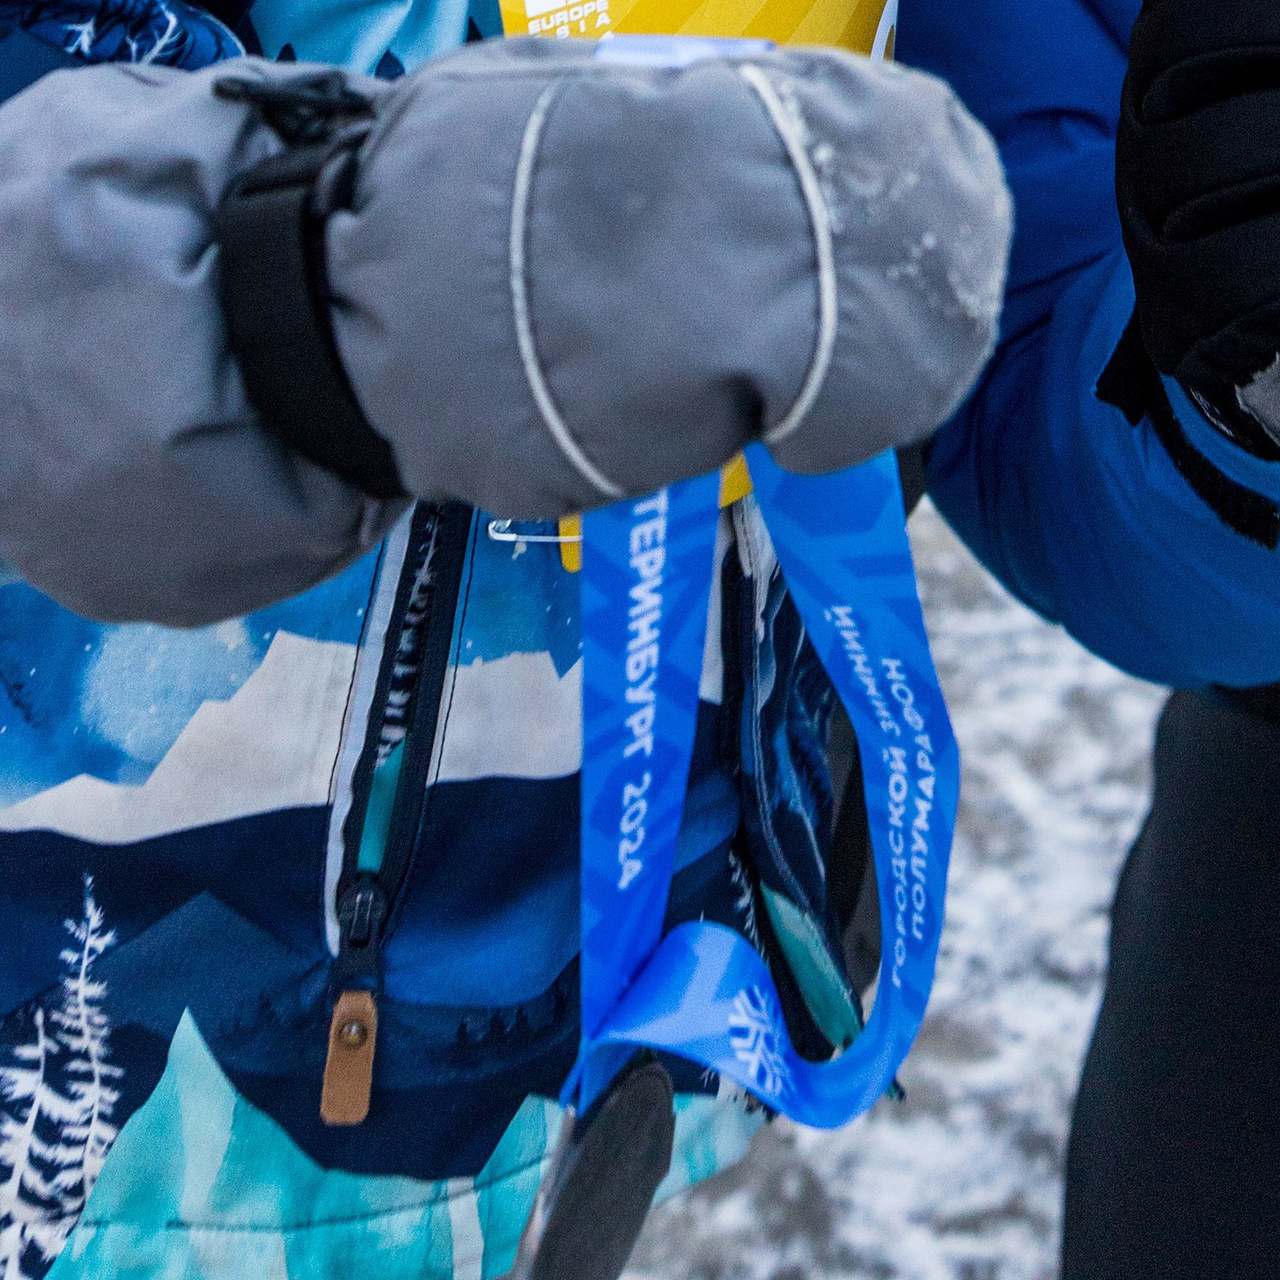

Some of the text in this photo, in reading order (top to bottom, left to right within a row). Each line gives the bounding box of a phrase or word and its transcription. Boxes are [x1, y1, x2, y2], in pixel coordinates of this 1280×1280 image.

[532, 12, 613, 40] SIA
[617, 771, 652, 889] 2024
[881, 657, 937, 941] ПОЛУМАРАФОН
